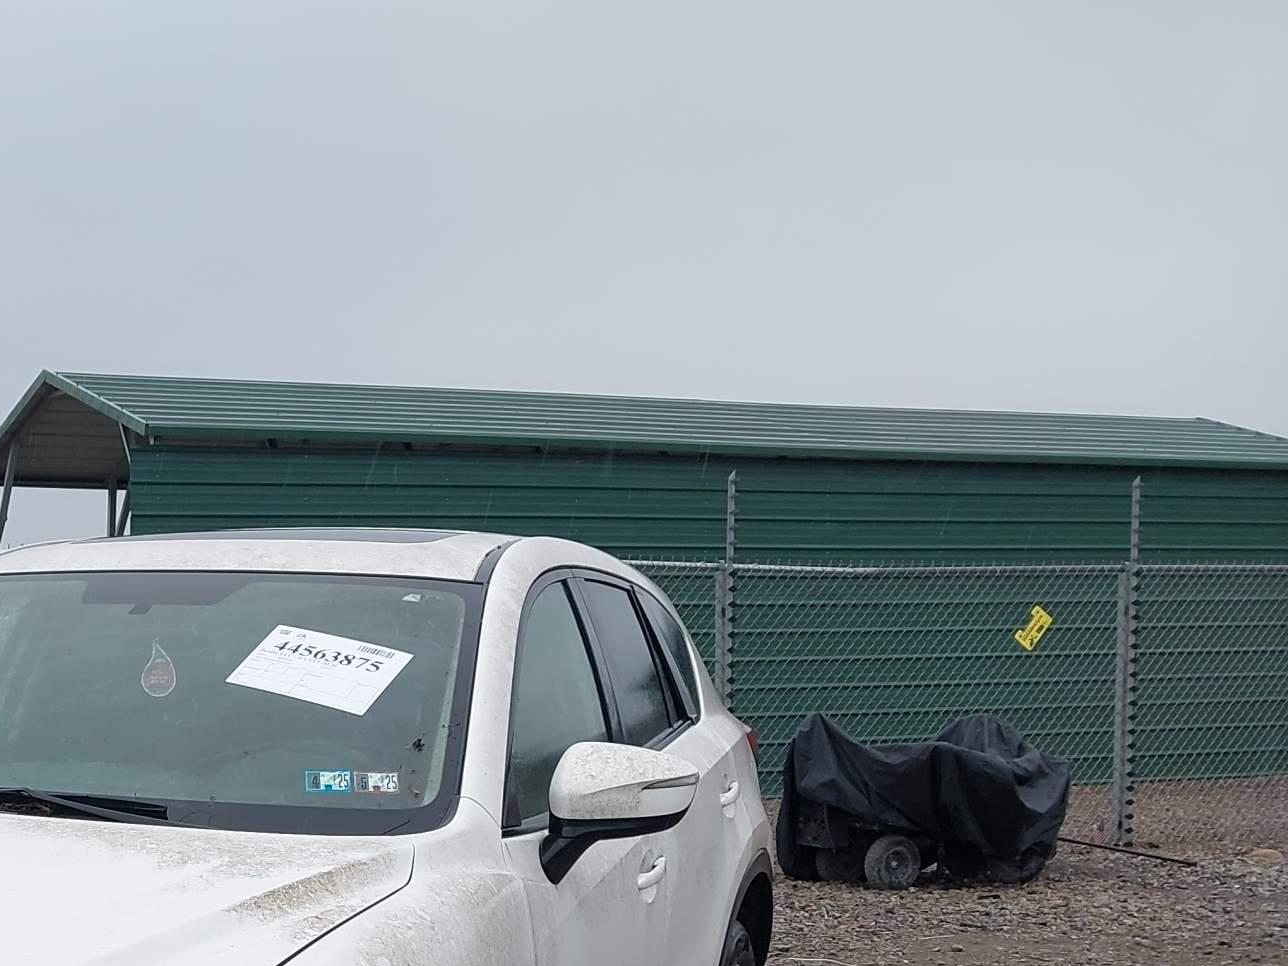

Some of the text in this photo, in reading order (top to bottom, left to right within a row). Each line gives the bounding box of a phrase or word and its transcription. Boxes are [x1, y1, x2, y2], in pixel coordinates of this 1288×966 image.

[274, 641, 384, 672] 44563875
[312, 774, 349, 790] 4 25
[385, 774, 398, 790] 25
